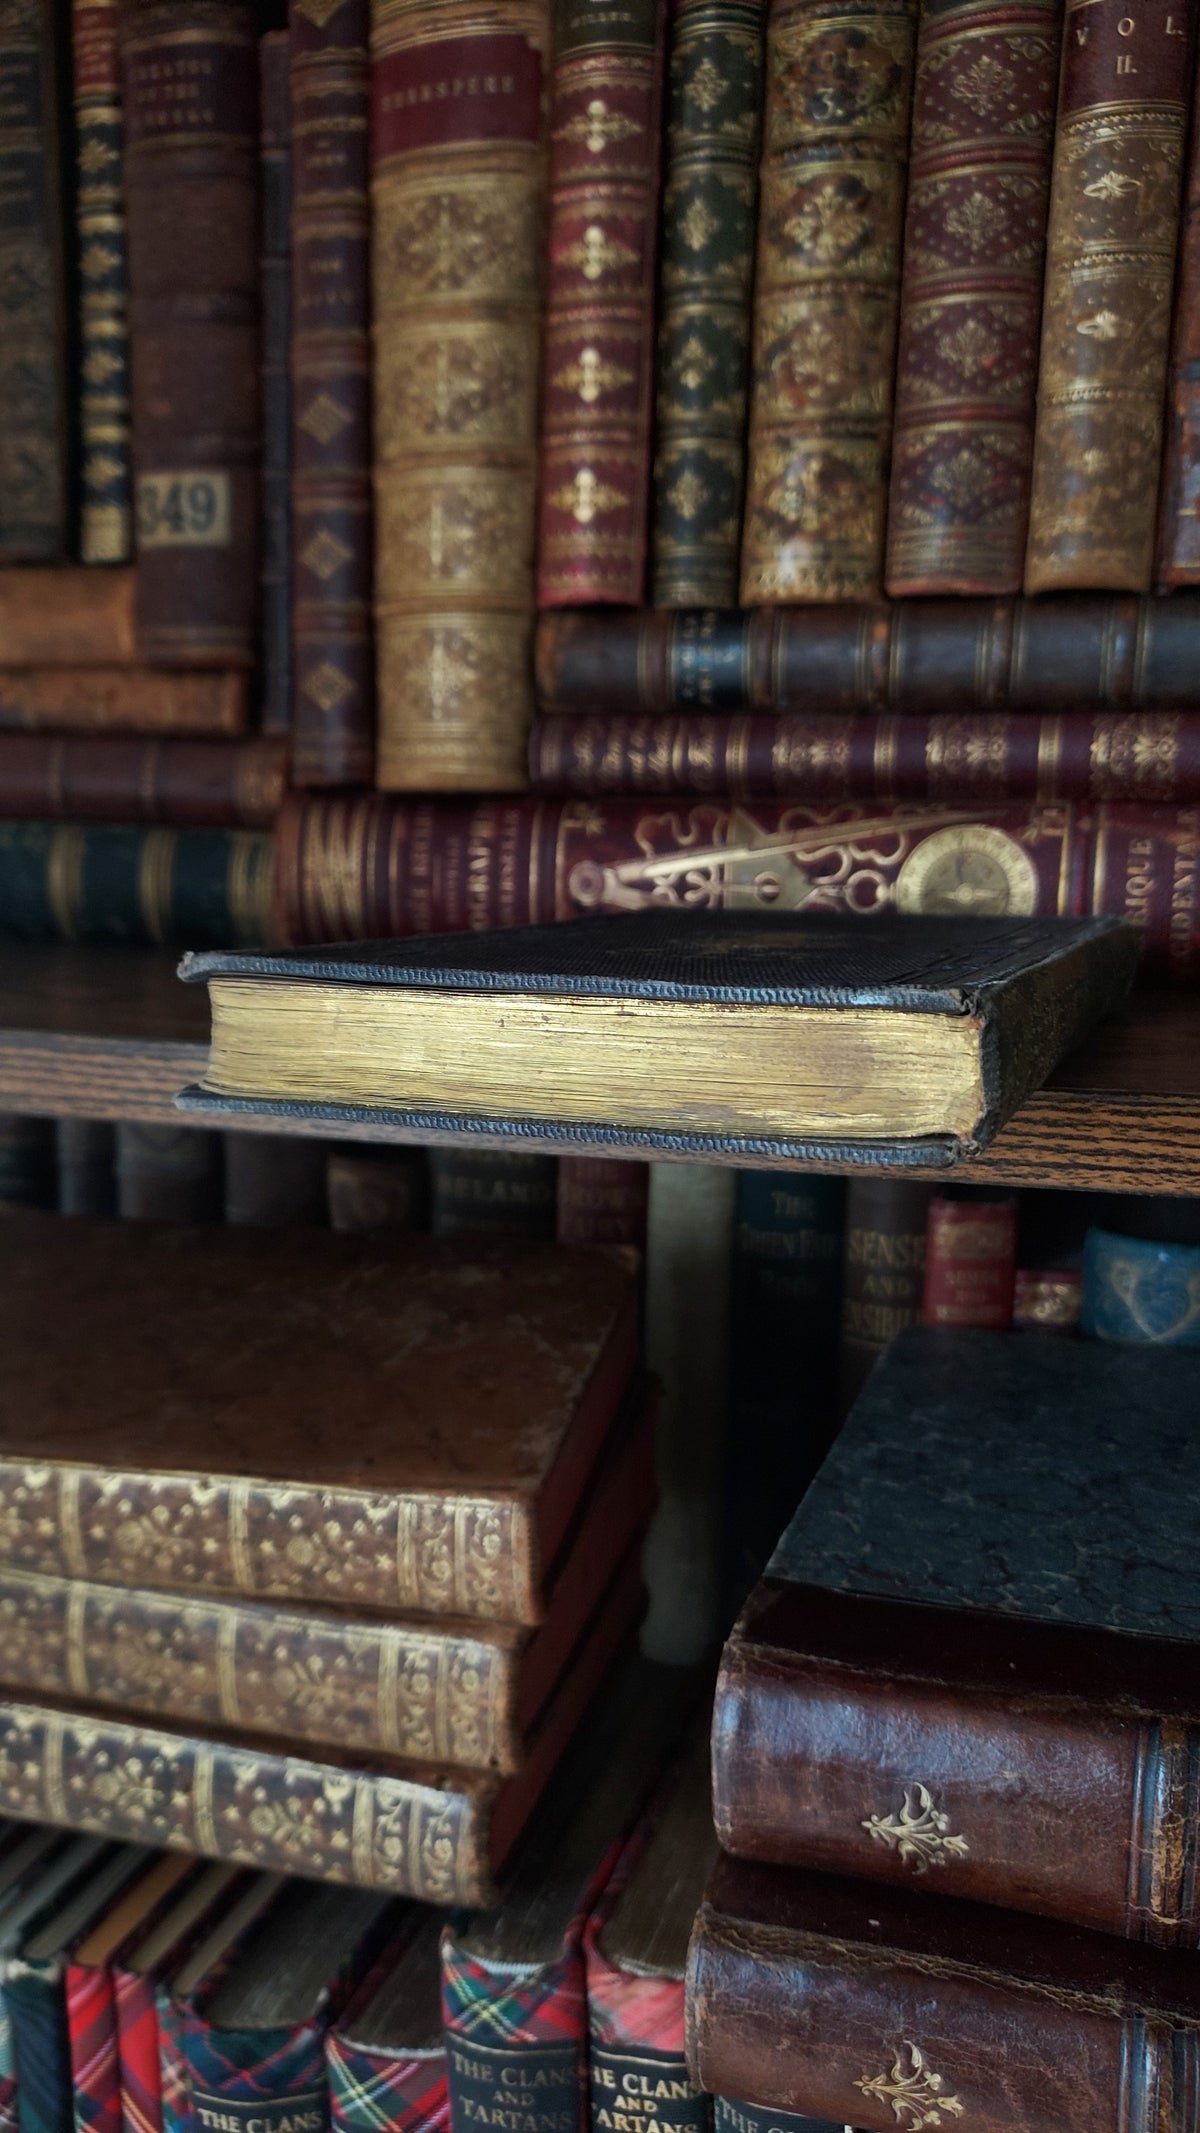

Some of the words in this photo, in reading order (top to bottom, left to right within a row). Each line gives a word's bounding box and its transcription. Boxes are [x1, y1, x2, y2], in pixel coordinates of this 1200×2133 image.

[1115, 54, 1139, 76] II.
[450, 2049, 494, 2082] THE
[493, 2089, 536, 2107] AND
[613, 2094, 659, 2113] AND
[196, 2106, 241, 2133] THE
[590, 2102, 700, 2133] ARTANS
